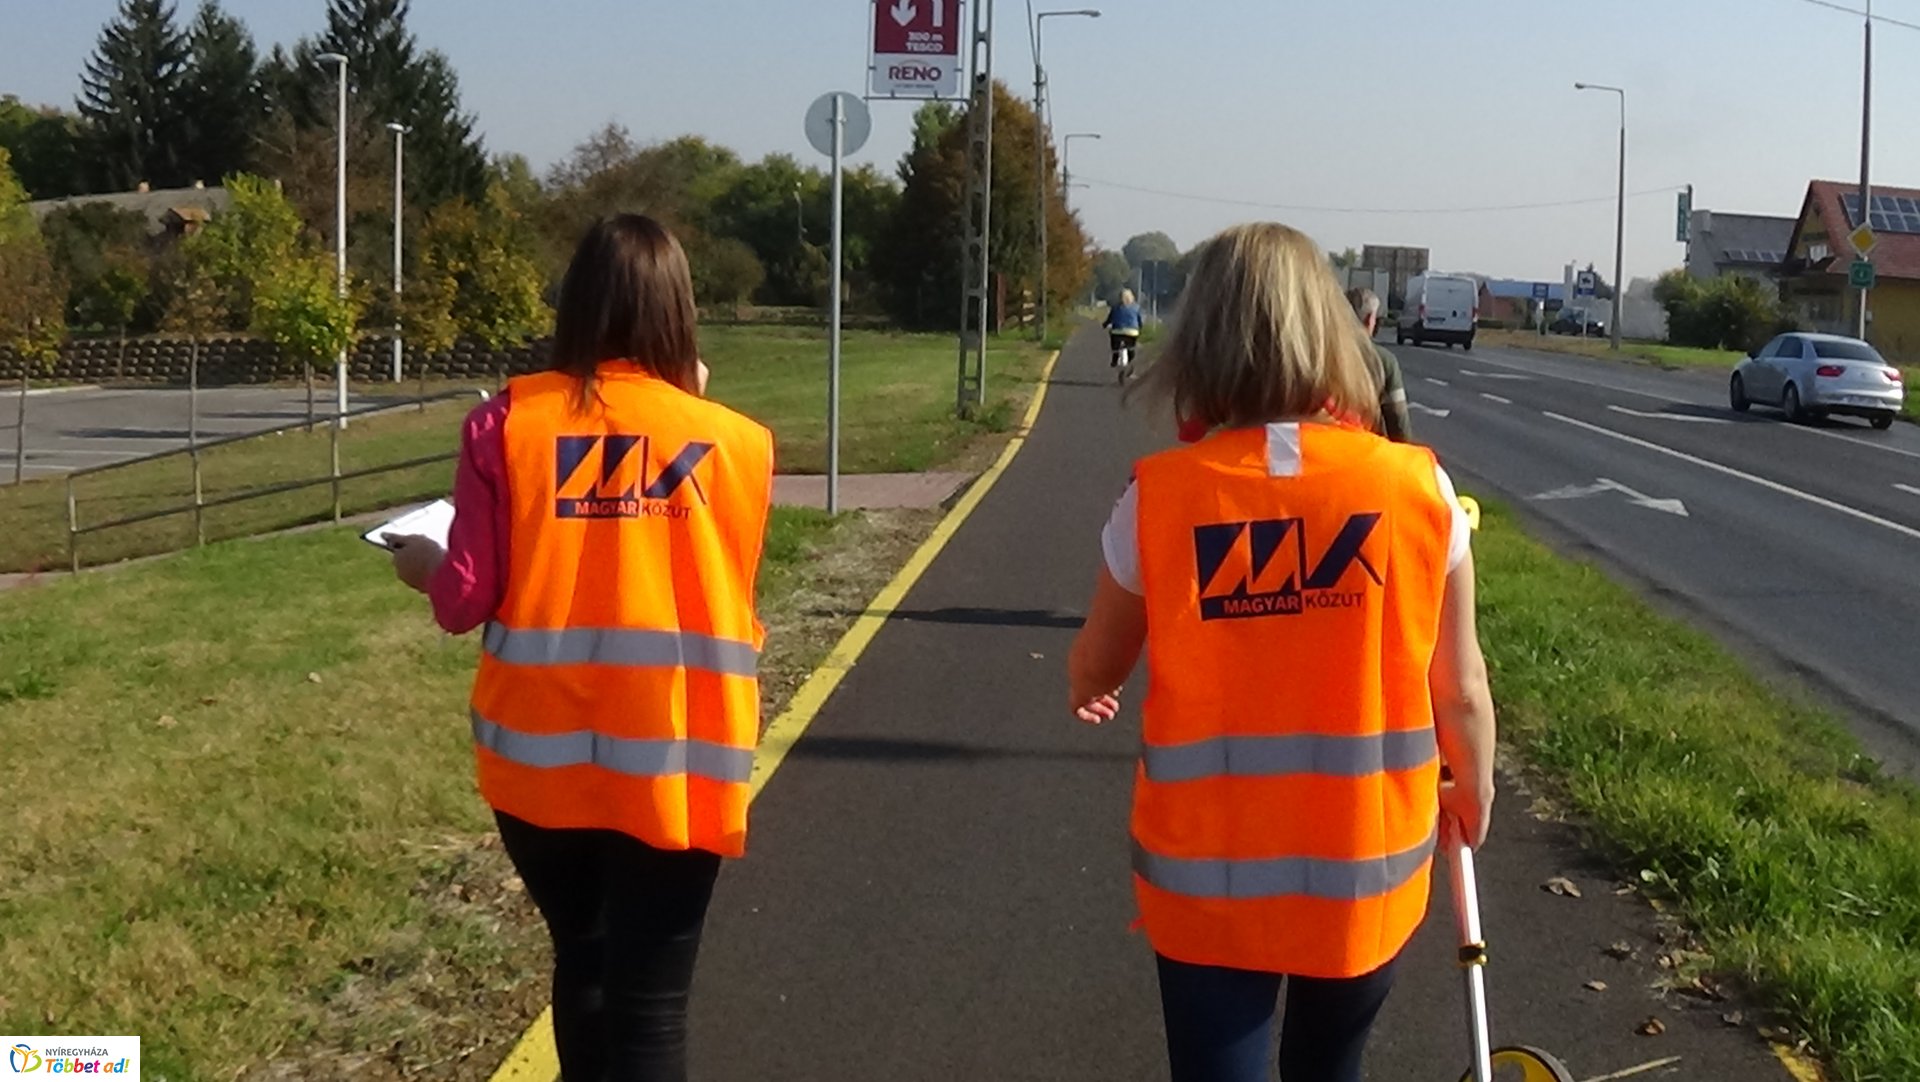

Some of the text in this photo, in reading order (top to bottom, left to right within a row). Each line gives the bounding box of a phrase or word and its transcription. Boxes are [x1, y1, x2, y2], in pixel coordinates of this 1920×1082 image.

[905, 42, 944, 52] TESCO
[888, 66, 942, 81] RENO
[575, 500, 638, 515] MAGYAR
[1223, 595, 1300, 614] MAGYAR
